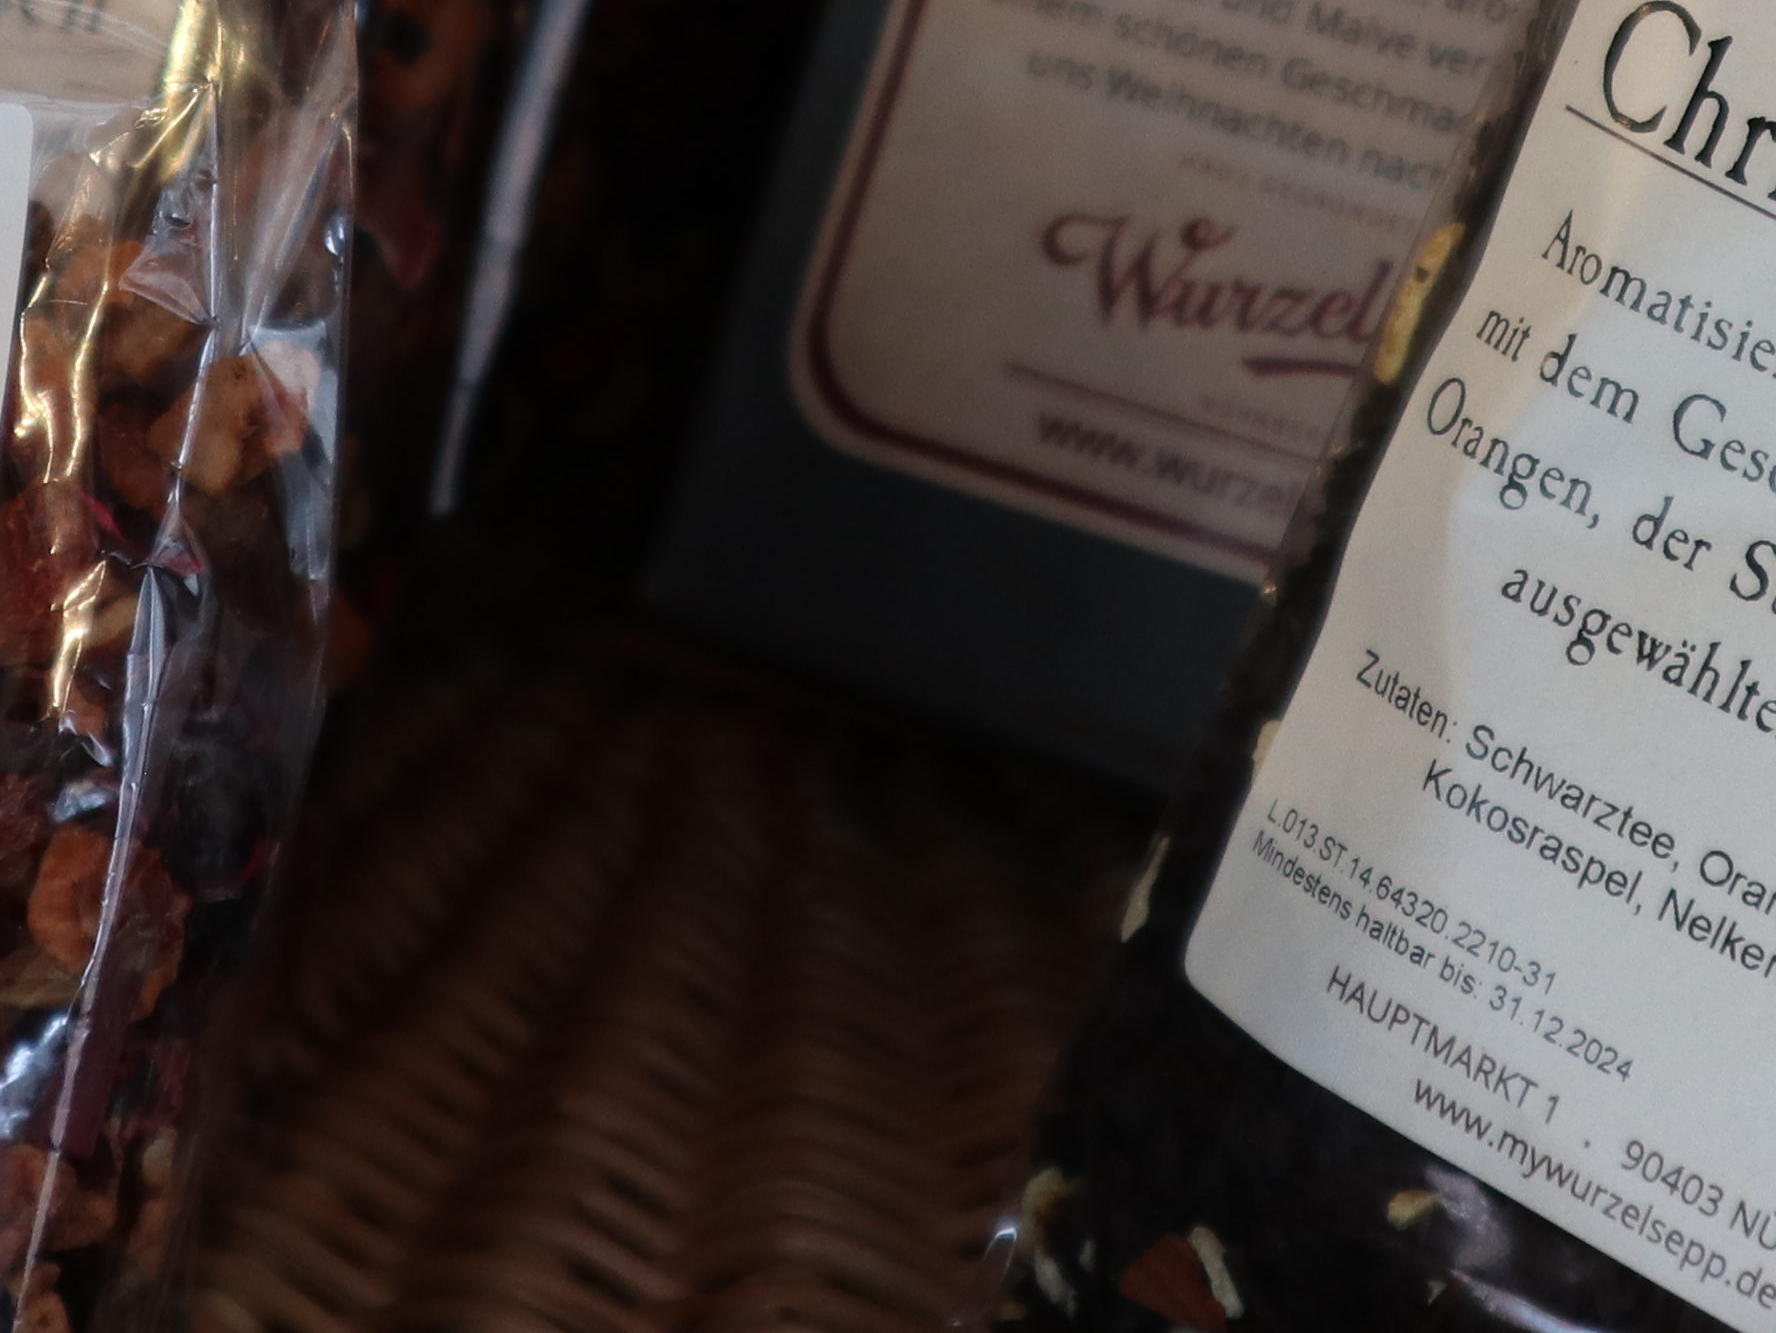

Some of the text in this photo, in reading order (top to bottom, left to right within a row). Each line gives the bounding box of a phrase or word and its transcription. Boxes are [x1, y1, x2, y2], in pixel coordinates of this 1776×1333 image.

[1476, 307, 1532, 364] mit
[1540, 333, 1641, 426] dem
[1426, 376, 1599, 530] Orangen,
[1633, 496, 1712, 573] der
[1355, 648, 1457, 745] Zutaten:
[1465, 723, 1681, 872] Schwarztee,
[1423, 760, 1645, 915] Kokosraspel,
[1252, 829, 1634, 1083] Mindestens haltbar bis: 31.12.2024
[1267, 799, 1558, 997] L.013.ST.14.64320.2210-31
[1326, 964, 1539, 1111] HAUPTMARKT
[1543, 1091, 1562, 1126] 1
[1622, 1137, 1726, 1220] 90403
